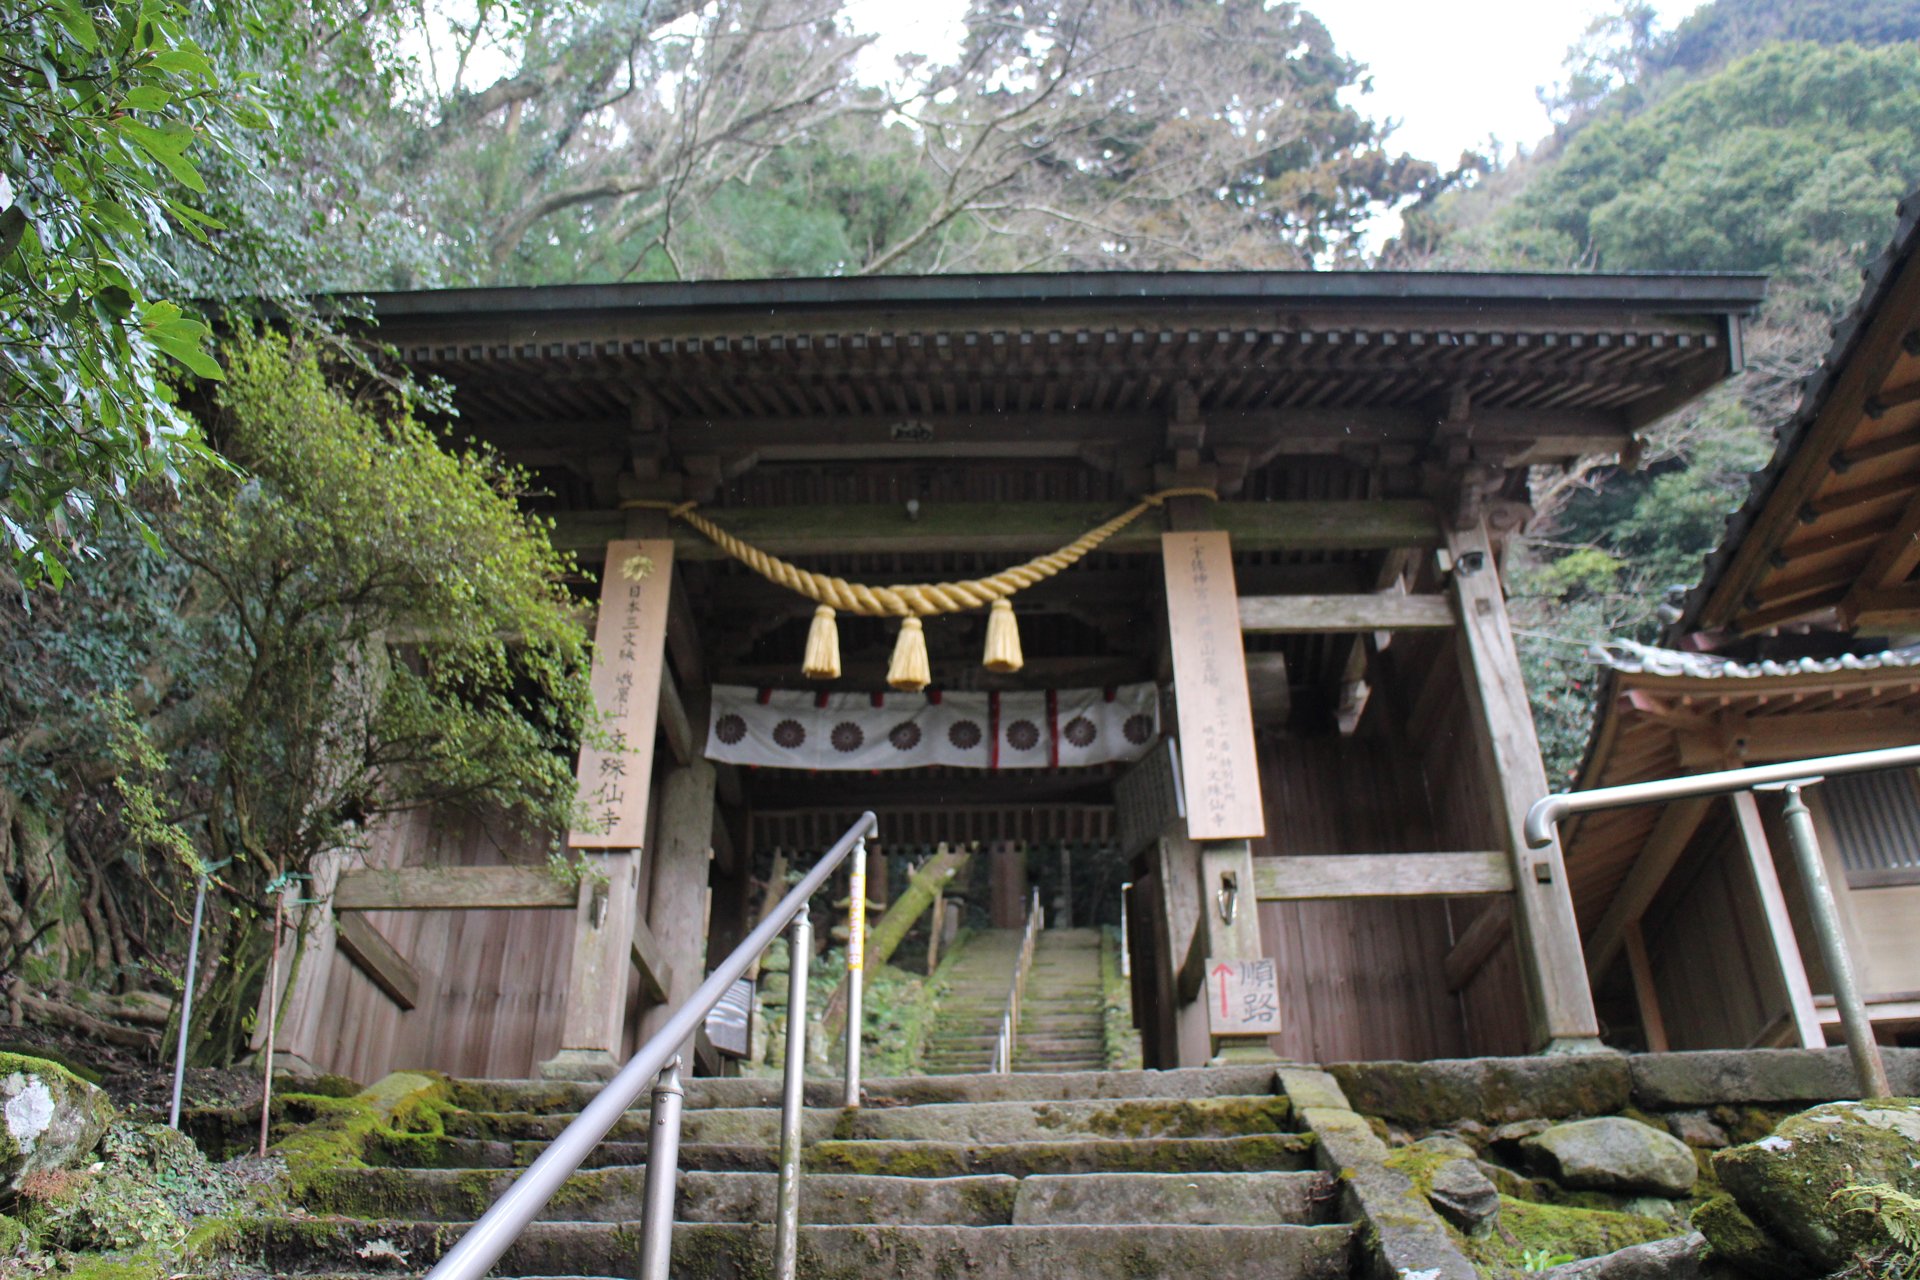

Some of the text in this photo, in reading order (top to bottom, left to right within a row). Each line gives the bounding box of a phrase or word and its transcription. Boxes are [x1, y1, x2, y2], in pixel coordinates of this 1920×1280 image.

[597, 728, 631, 837] 文殊仙寺
[1239, 960, 1277, 1024] 順路
